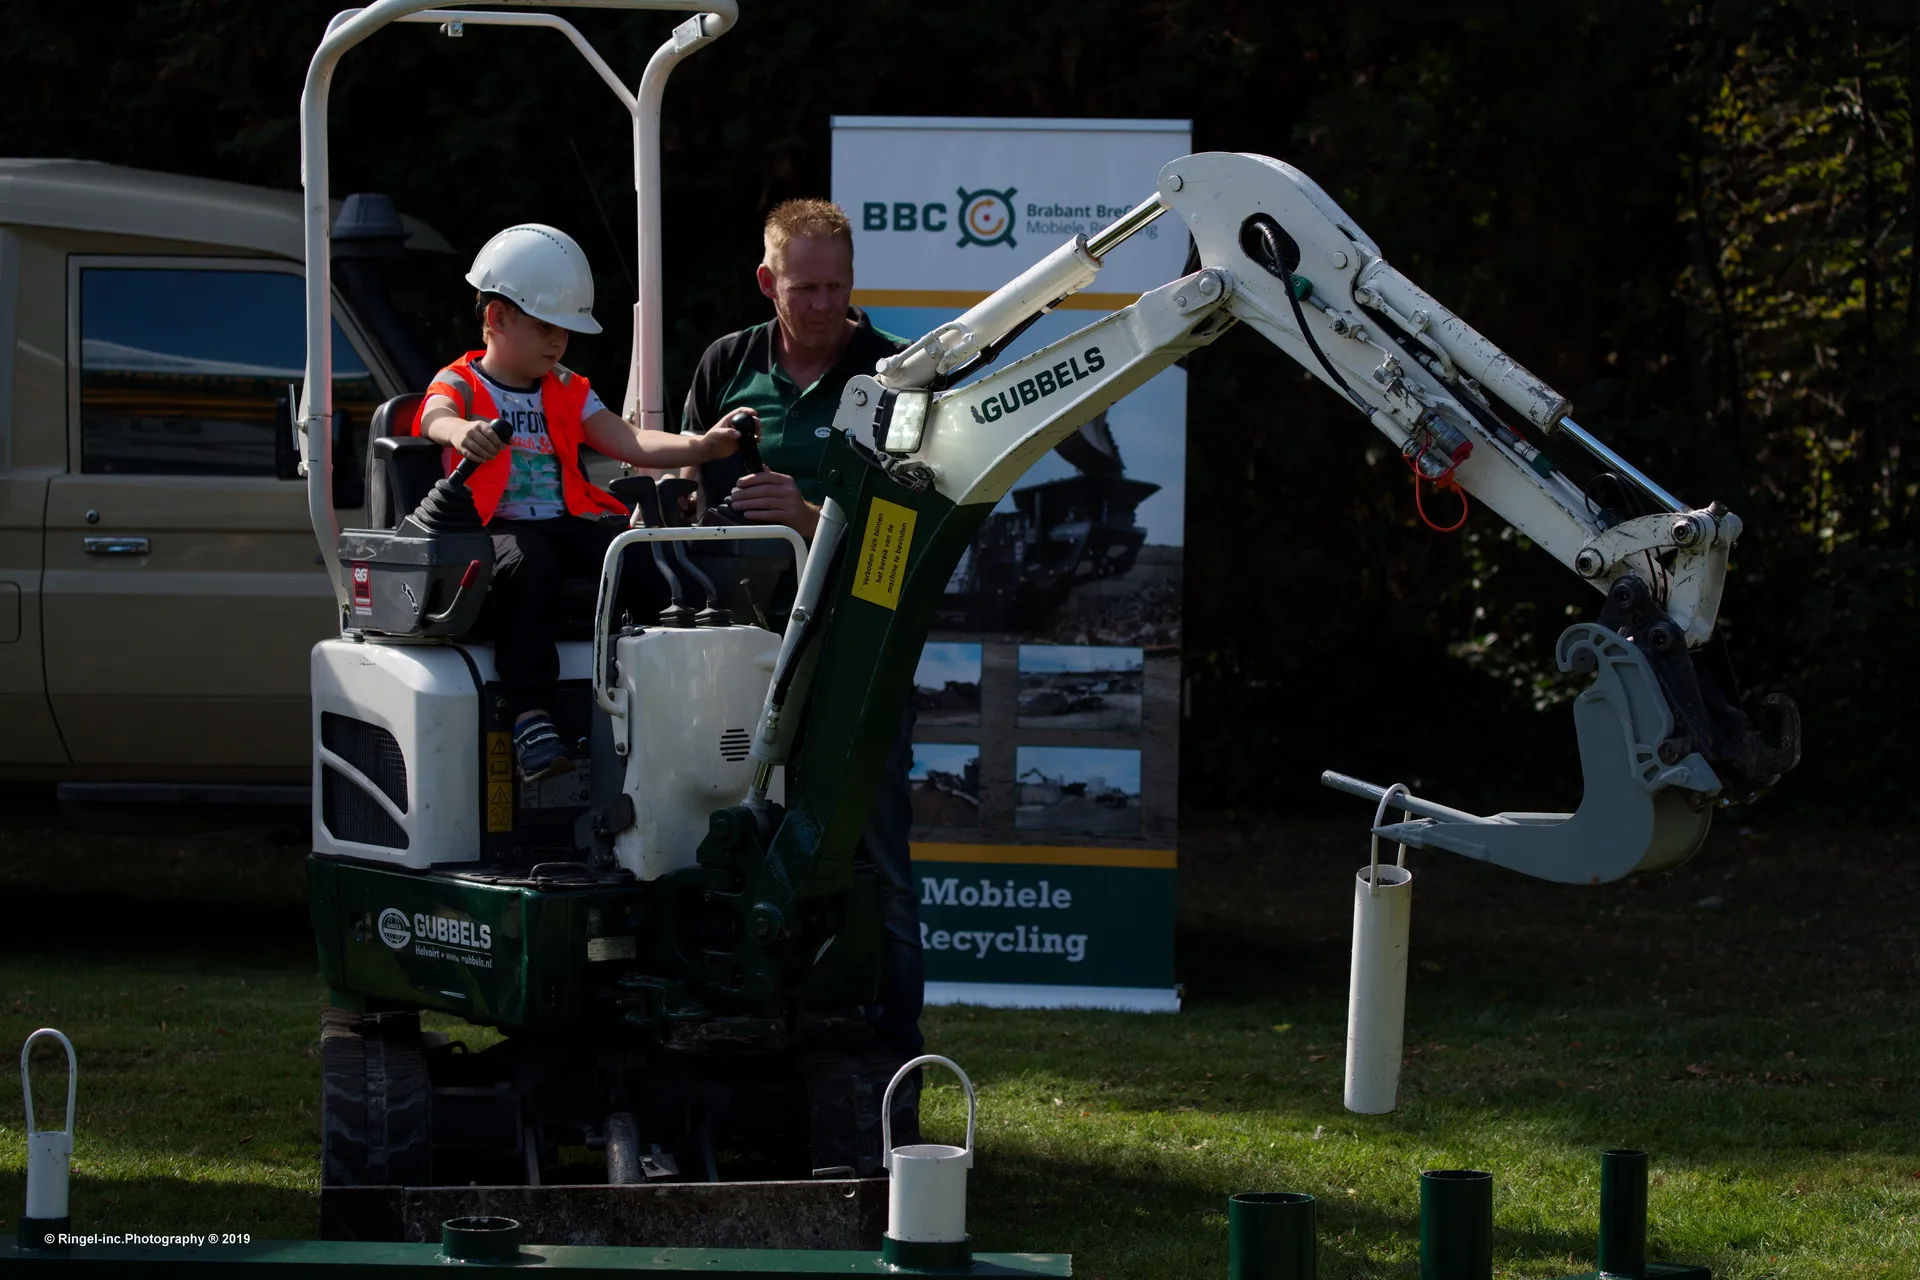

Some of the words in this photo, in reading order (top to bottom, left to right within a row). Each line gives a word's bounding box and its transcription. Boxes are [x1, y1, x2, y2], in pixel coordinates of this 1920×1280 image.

[862, 202, 947, 231] BBC
[1027, 203, 1090, 218] Brabant
[1027, 220, 1084, 235] Mobiele
[981, 346, 1105, 423] GUBBELS
[862, 553, 875, 586] Verboden
[874, 512, 884, 537] binnen
[879, 549, 889, 571] bereik
[886, 524, 894, 533] de
[887, 564, 898, 594] machine
[895, 522, 907, 555] bevinden
[920, 877, 1072, 909] Mobiele
[413, 913, 492, 949] GUBBELS
[415, 945, 441, 959] Helvoirt
